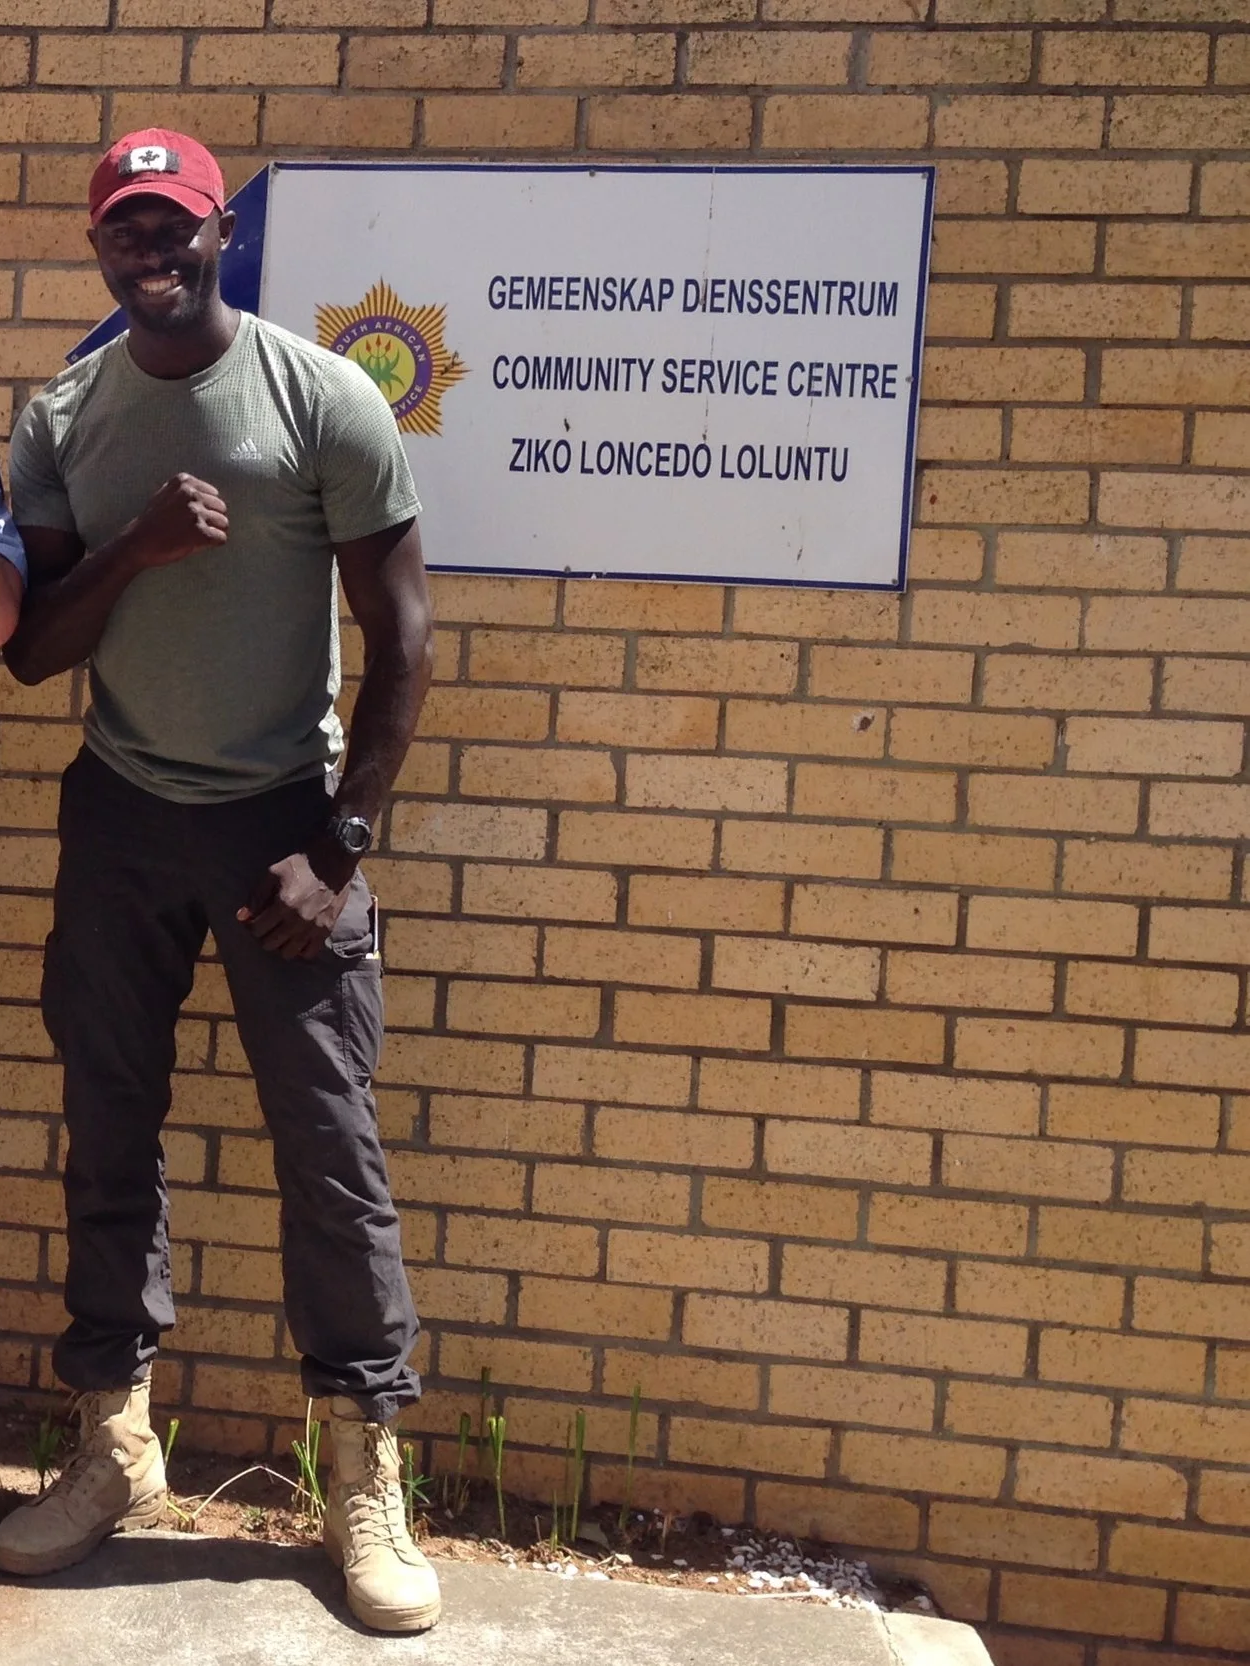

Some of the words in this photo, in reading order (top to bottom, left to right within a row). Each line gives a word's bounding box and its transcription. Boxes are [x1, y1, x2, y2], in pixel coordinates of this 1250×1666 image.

[488, 275, 676, 313] GEMEENSKAP
[682, 278, 900, 317] DIENSSENTRUM
[337, 323, 368, 353] OUTH
[374, 320, 427, 363] AFRICAN
[492, 354, 656, 393] COMMUNITY
[661, 358, 780, 397] SERVICE
[787, 361, 899, 399] CENTRE
[392, 384, 424, 416] RVICE
[508, 437, 572, 475] ZIKO
[580, 440, 712, 479] LONCEDO
[720, 444, 849, 482] LOLUNTU
